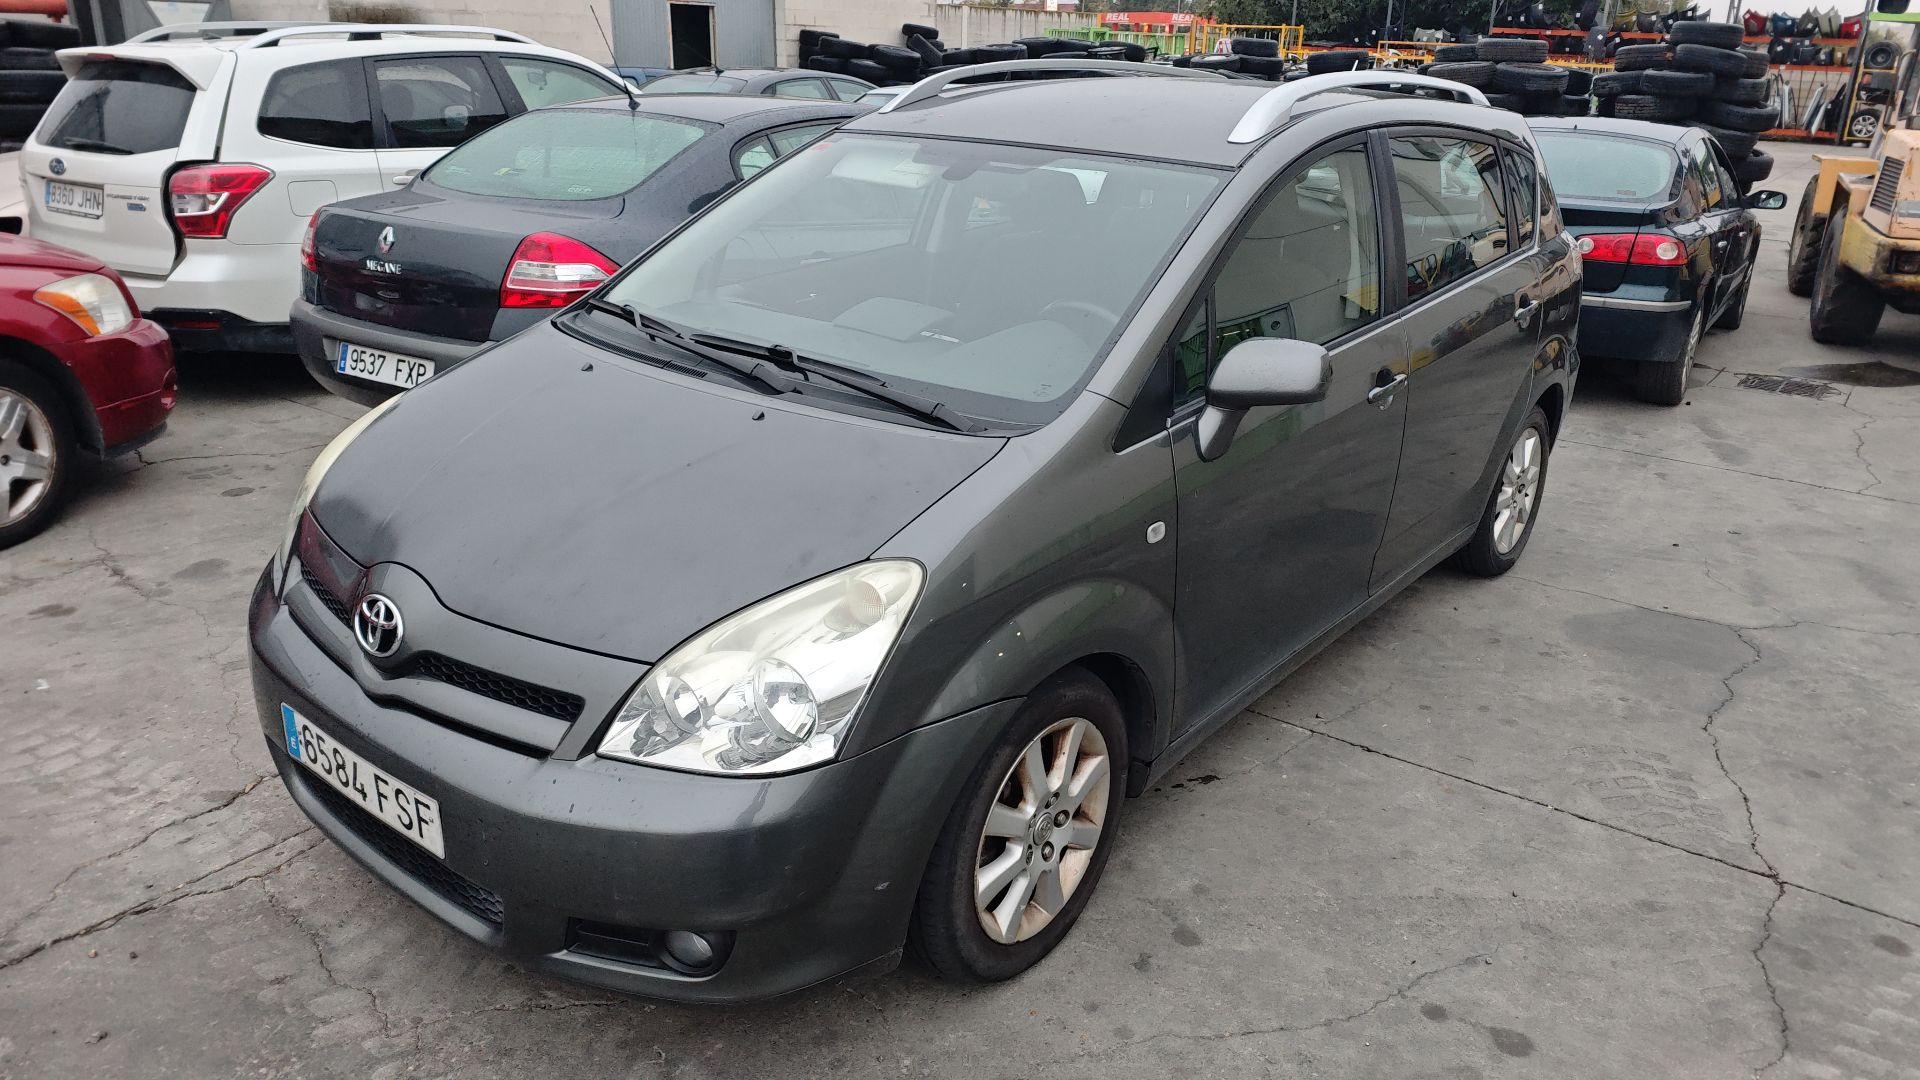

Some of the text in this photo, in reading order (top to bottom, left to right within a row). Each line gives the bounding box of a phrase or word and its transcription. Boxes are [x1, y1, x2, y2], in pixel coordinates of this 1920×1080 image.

[1106, 13, 1130, 21] REAL
[77, 189, 101, 211] JHN
[366, 259, 402, 275] MEGANE
[350, 348, 427, 385] 9537 FXP
[302, 724, 431, 839] 6584 FSF
